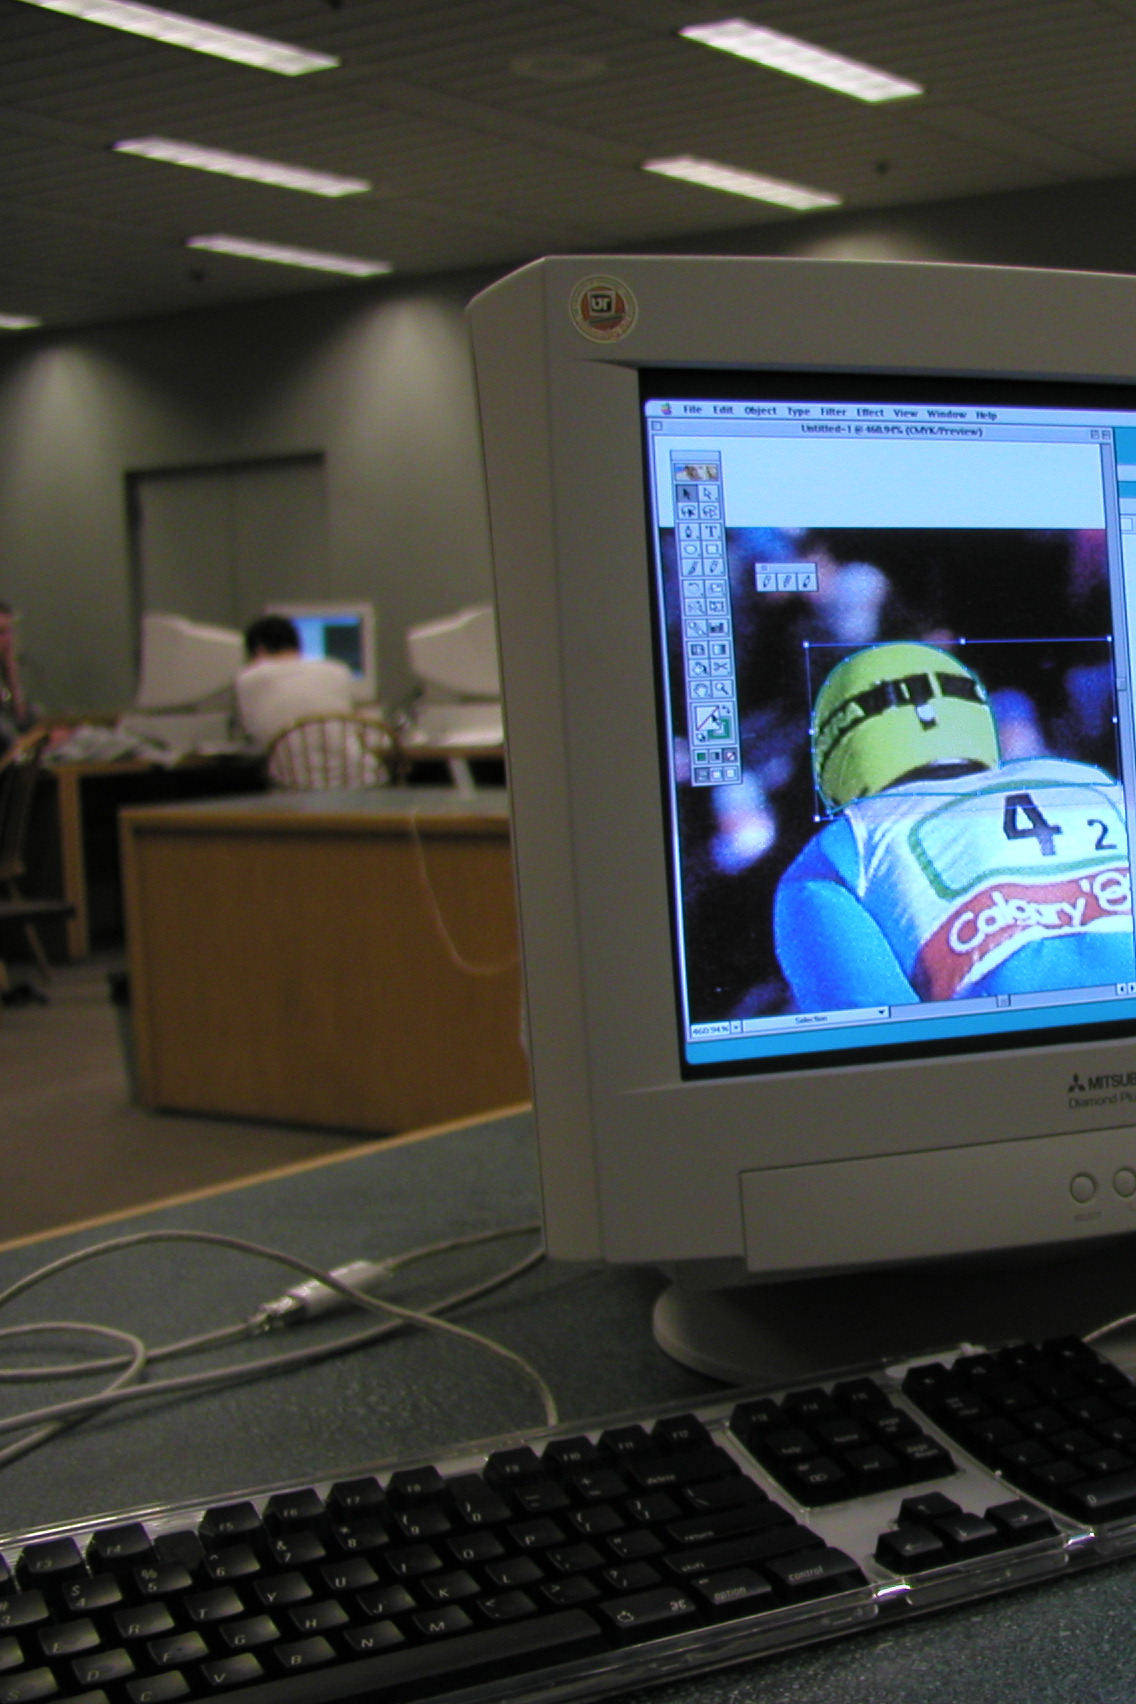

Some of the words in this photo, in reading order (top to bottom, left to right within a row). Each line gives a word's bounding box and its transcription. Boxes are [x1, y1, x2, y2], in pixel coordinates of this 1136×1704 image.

[683, 405, 703, 415] File
[713, 405, 734, 415] Edit
[744, 406, 777, 418] Object
[787, 407, 811, 418] Type
[820, 407, 848, 417] Filter
[857, 407, 885, 418] Effect
[893, 408, 919, 417] View
[926, 409, 967, 419] Window
[976, 410, 998, 421] Help
[801, 424, 852, 434] Untitled-1
[1003, 792, 1063, 856] 4
[1086, 818, 1117, 851] 2
[795, 1014, 828, 1024] Selection
[1068, 1094, 1118, 1109] Diamond
[645, 1474, 677, 1485] delete
[346, 1496, 361, 1506] F7
[283, 1508, 298, 1518] F6
[218, 1522, 234, 1532] F5
[524, 1536, 536, 1546] P
[684, 1530, 715, 1542] return
[347, 1538, 357, 1548] 8
[106, 1545, 122, 1554] F4
[284, 1553, 293, 1562] 7
[36, 1560, 53, 1569] F3
[216, 1567, 226, 1577] 6
[789, 1566, 824, 1580] control
[335, 1577, 347, 1588] U
[502, 1574, 511, 1584] L
[148, 1582, 157, 1592] 5
[266, 1592, 277, 1603] Y
[438, 1588, 450, 1598] K
[713, 1587, 747, 1600] option
[76, 1598, 86, 1608] 4
[197, 1609, 207, 1619] T
[373, 1604, 383, 1614] J
[305, 1619, 317, 1629] H
[429, 1621, 445, 1632] M
[128, 1625, 140, 1634] R
[234, 1635, 247, 1646] G
[361, 1638, 374, 1648] N
[163, 1652, 172, 1662] F
[291, 1655, 302, 1665] B
[87, 1670, 100, 1681] D
[214, 1672, 226, 1683] V
[140, 1691, 152, 1701] C
